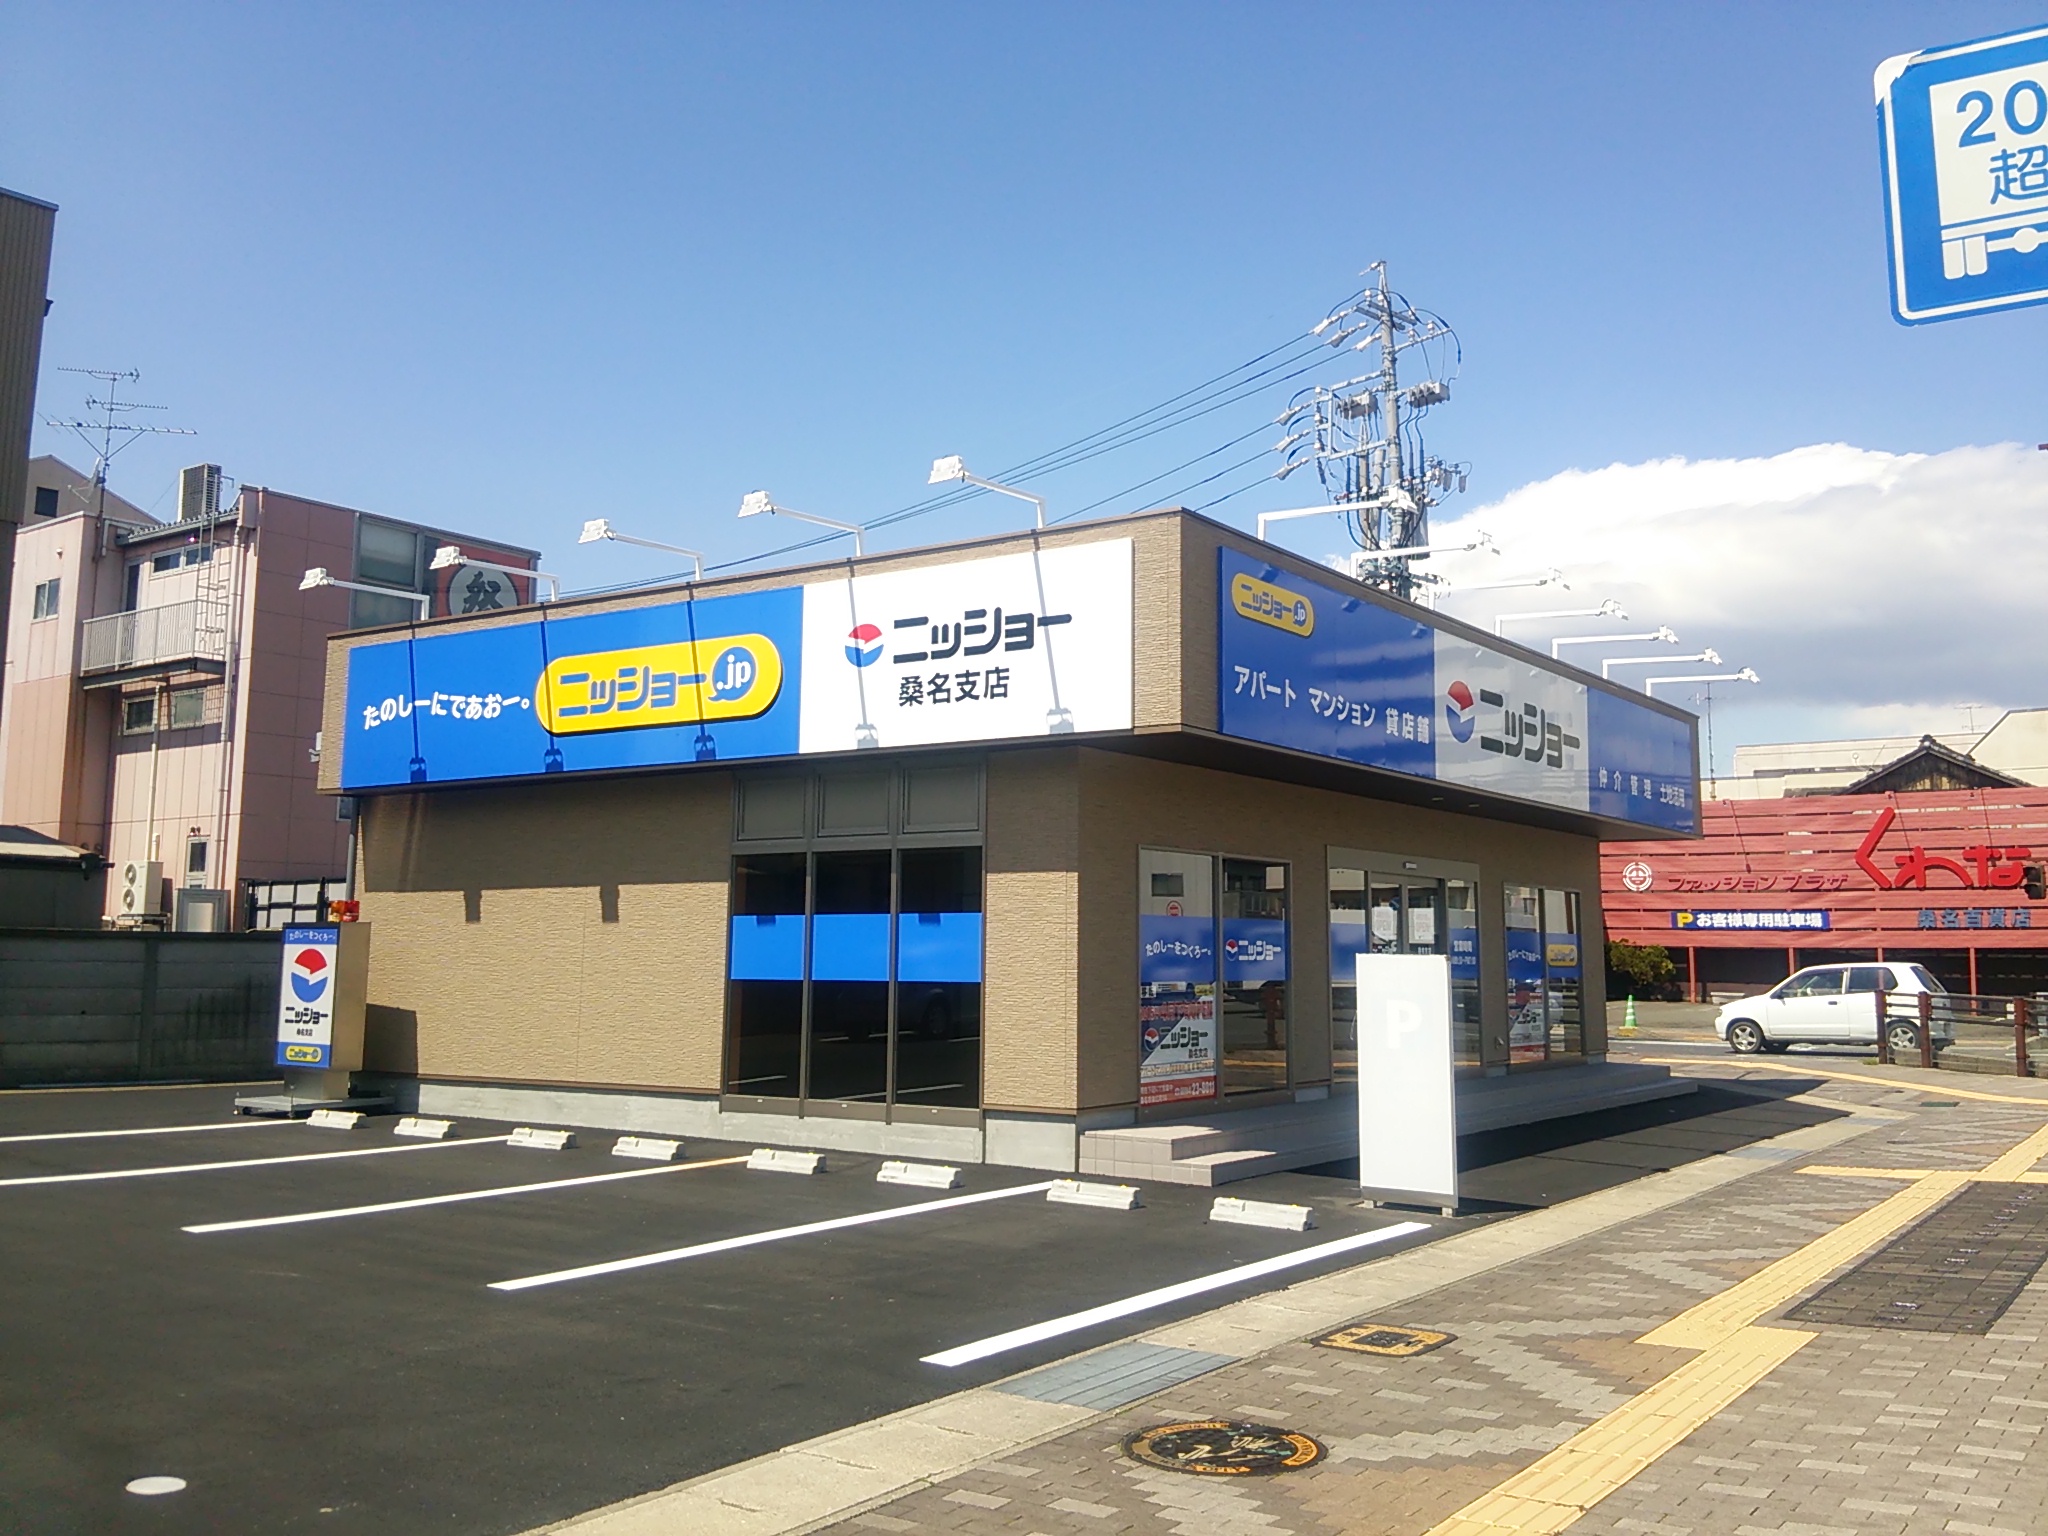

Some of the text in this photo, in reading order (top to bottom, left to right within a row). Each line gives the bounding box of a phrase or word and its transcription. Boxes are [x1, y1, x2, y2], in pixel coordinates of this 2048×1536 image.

[1956, 79, 2048, 148] 20
[1989, 144, 2048, 205] 超
[892, 606, 1073, 665] ニッショー
[898, 666, 1010, 707] 桑名支店
[1234, 665, 1297, 708] アパート
[1308, 687, 1376, 728] マンション
[362, 691, 530, 730] たのしーにであおー。
[1480, 688, 1580, 769] ニッショー
[1855, 806, 2031, 889] くわな
[1668, 874, 1849, 891] ファッションプラザ
[1696, 912, 1823, 928] お客様専用駐車場
[1917, 908, 2031, 928] 桑名百貨店
[1238, 940, 1282, 961] ニッショー
[285, 1006, 329, 1025] ニッショー
[1160, 1026, 1209, 1050] ニッショー
